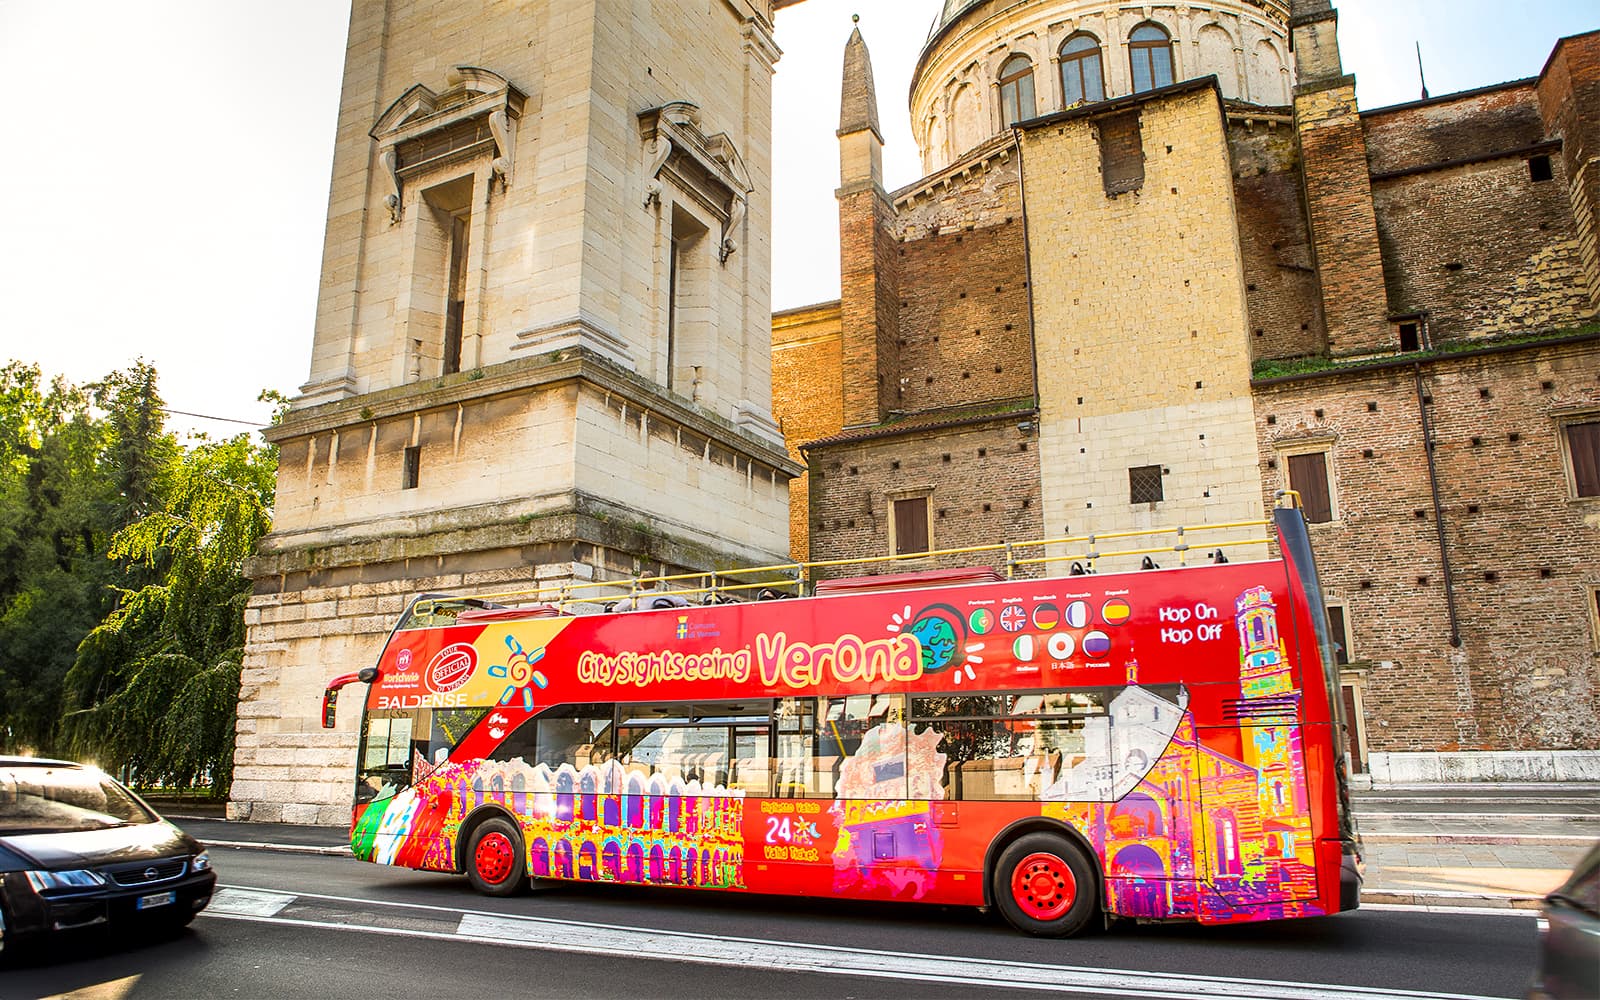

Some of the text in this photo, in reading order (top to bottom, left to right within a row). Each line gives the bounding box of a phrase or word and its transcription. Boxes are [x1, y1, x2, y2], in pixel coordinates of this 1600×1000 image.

[1159, 603, 1218, 623] Hop On
[1161, 624, 1223, 645] Hop Off
[434, 656, 469, 680] OFFICIAL
[756, 632, 924, 689] Verona
[378, 693, 468, 709] BALDENSE
[766, 817, 791, 843] 24
[764, 846, 819, 861] Valid Ticket
